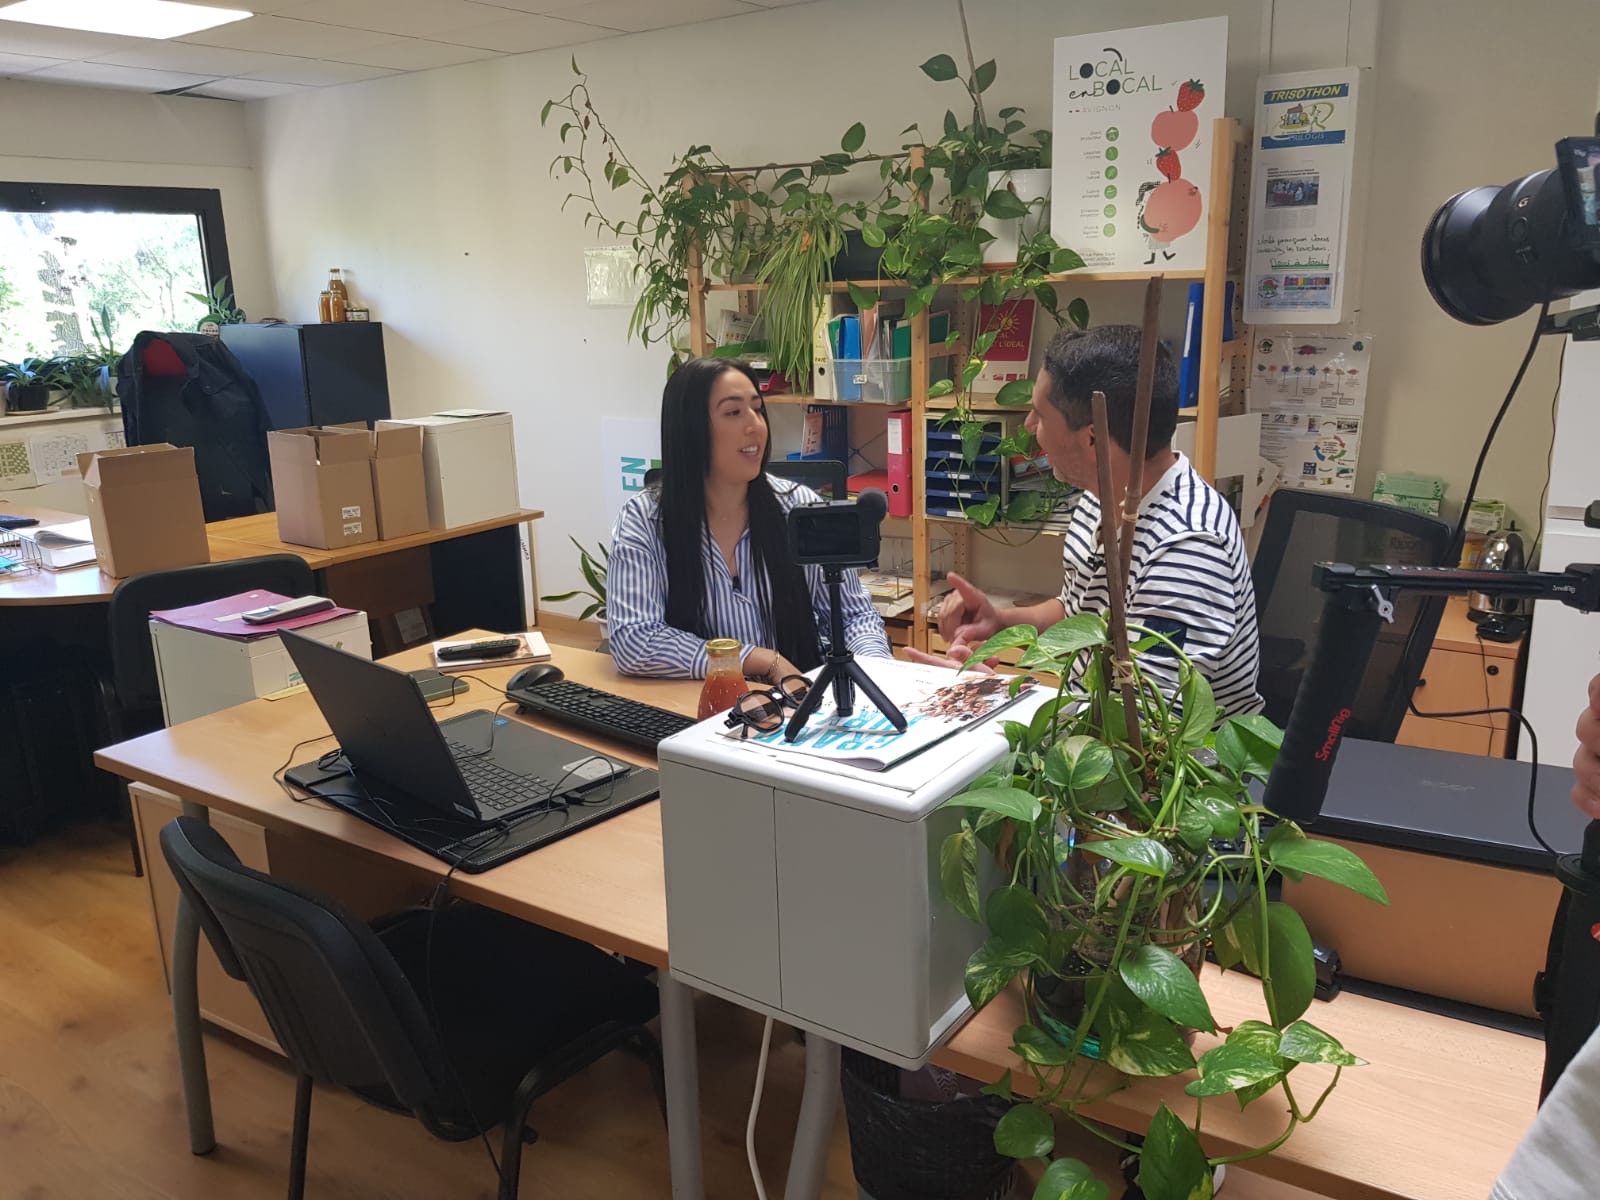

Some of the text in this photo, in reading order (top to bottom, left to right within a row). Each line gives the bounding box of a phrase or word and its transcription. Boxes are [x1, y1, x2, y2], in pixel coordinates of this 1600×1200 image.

[1069, 58, 1135, 81] LOCAL
[1069, 74, 1163, 100] en BOCAL
[1270, 85, 1342, 102] TRISOTHON
[1081, 103, 1122, 113] AVIGNON
[620, 456, 647, 492] EN
[1315, 708, 1351, 761] SmallRig
